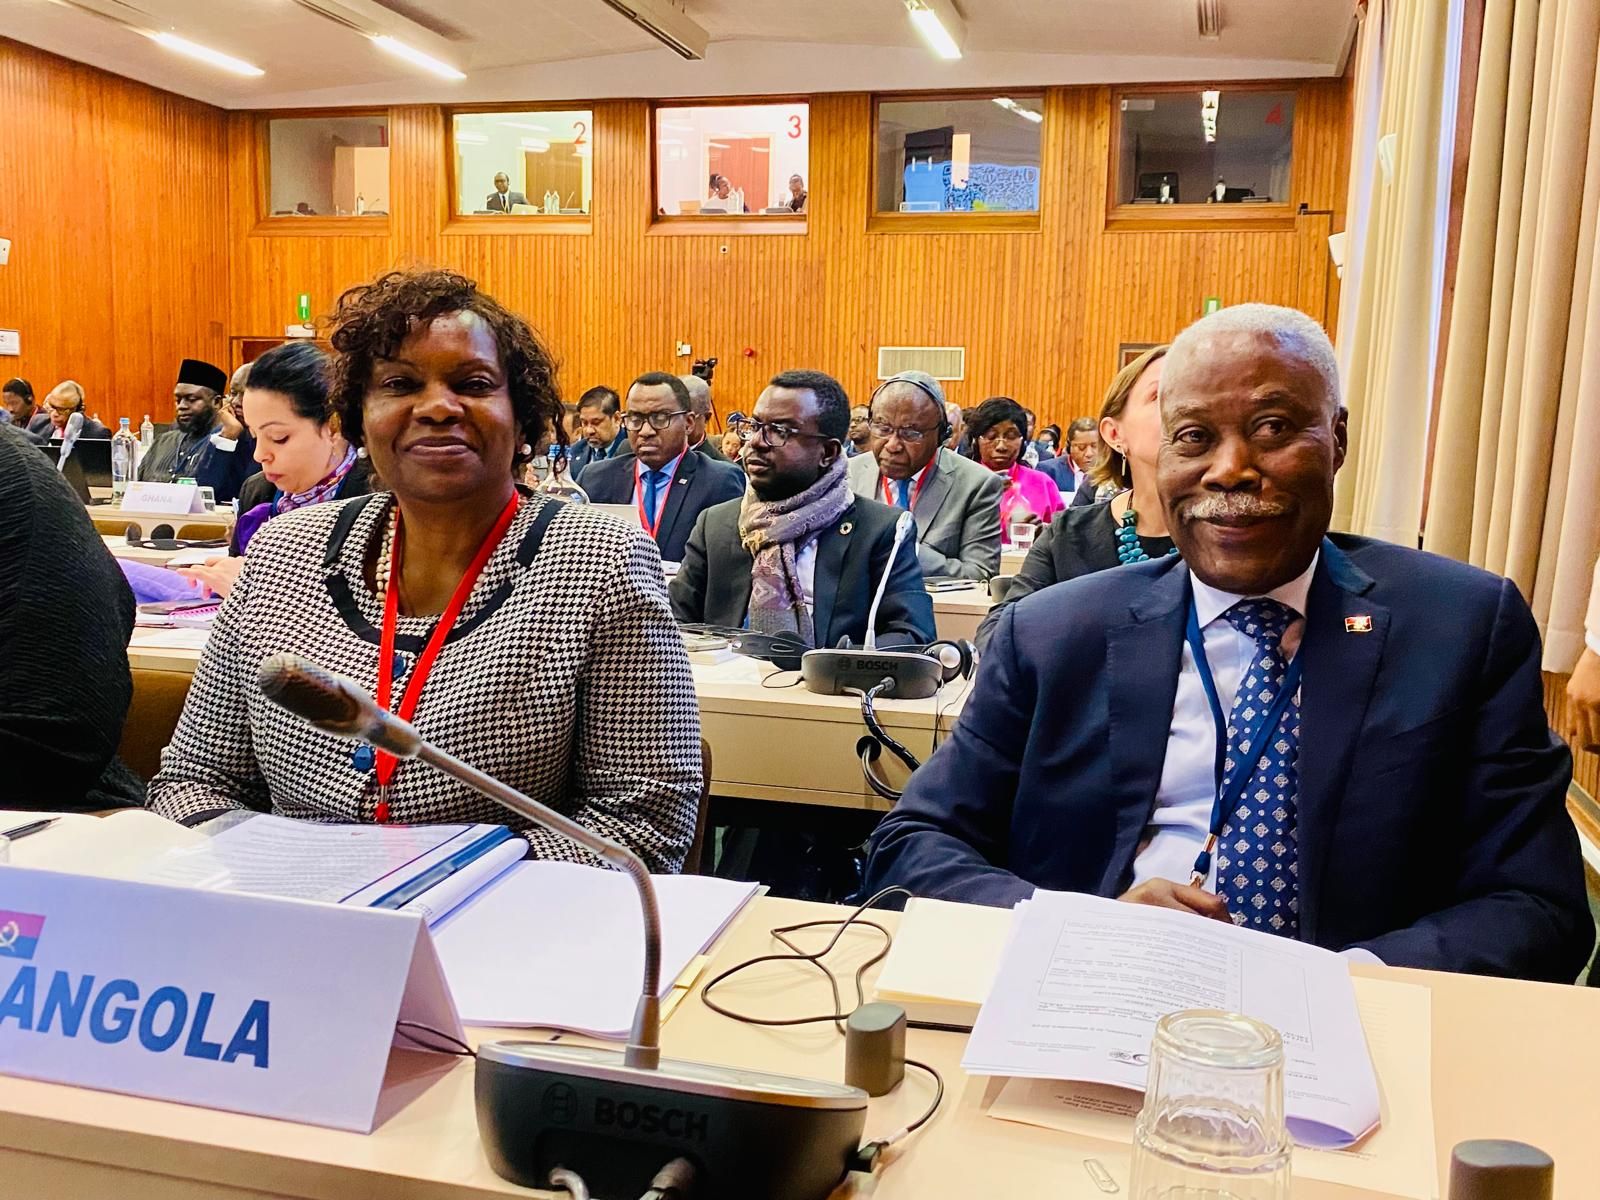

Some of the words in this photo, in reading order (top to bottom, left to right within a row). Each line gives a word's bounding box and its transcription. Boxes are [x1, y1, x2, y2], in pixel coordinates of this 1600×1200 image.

[573, 121, 587, 144] 2
[787, 115, 802, 139] 3
[857, 659, 898, 671] BOSCH
[0, 965, 270, 1069] ANGOLA
[594, 1097, 709, 1142] BOSCH
